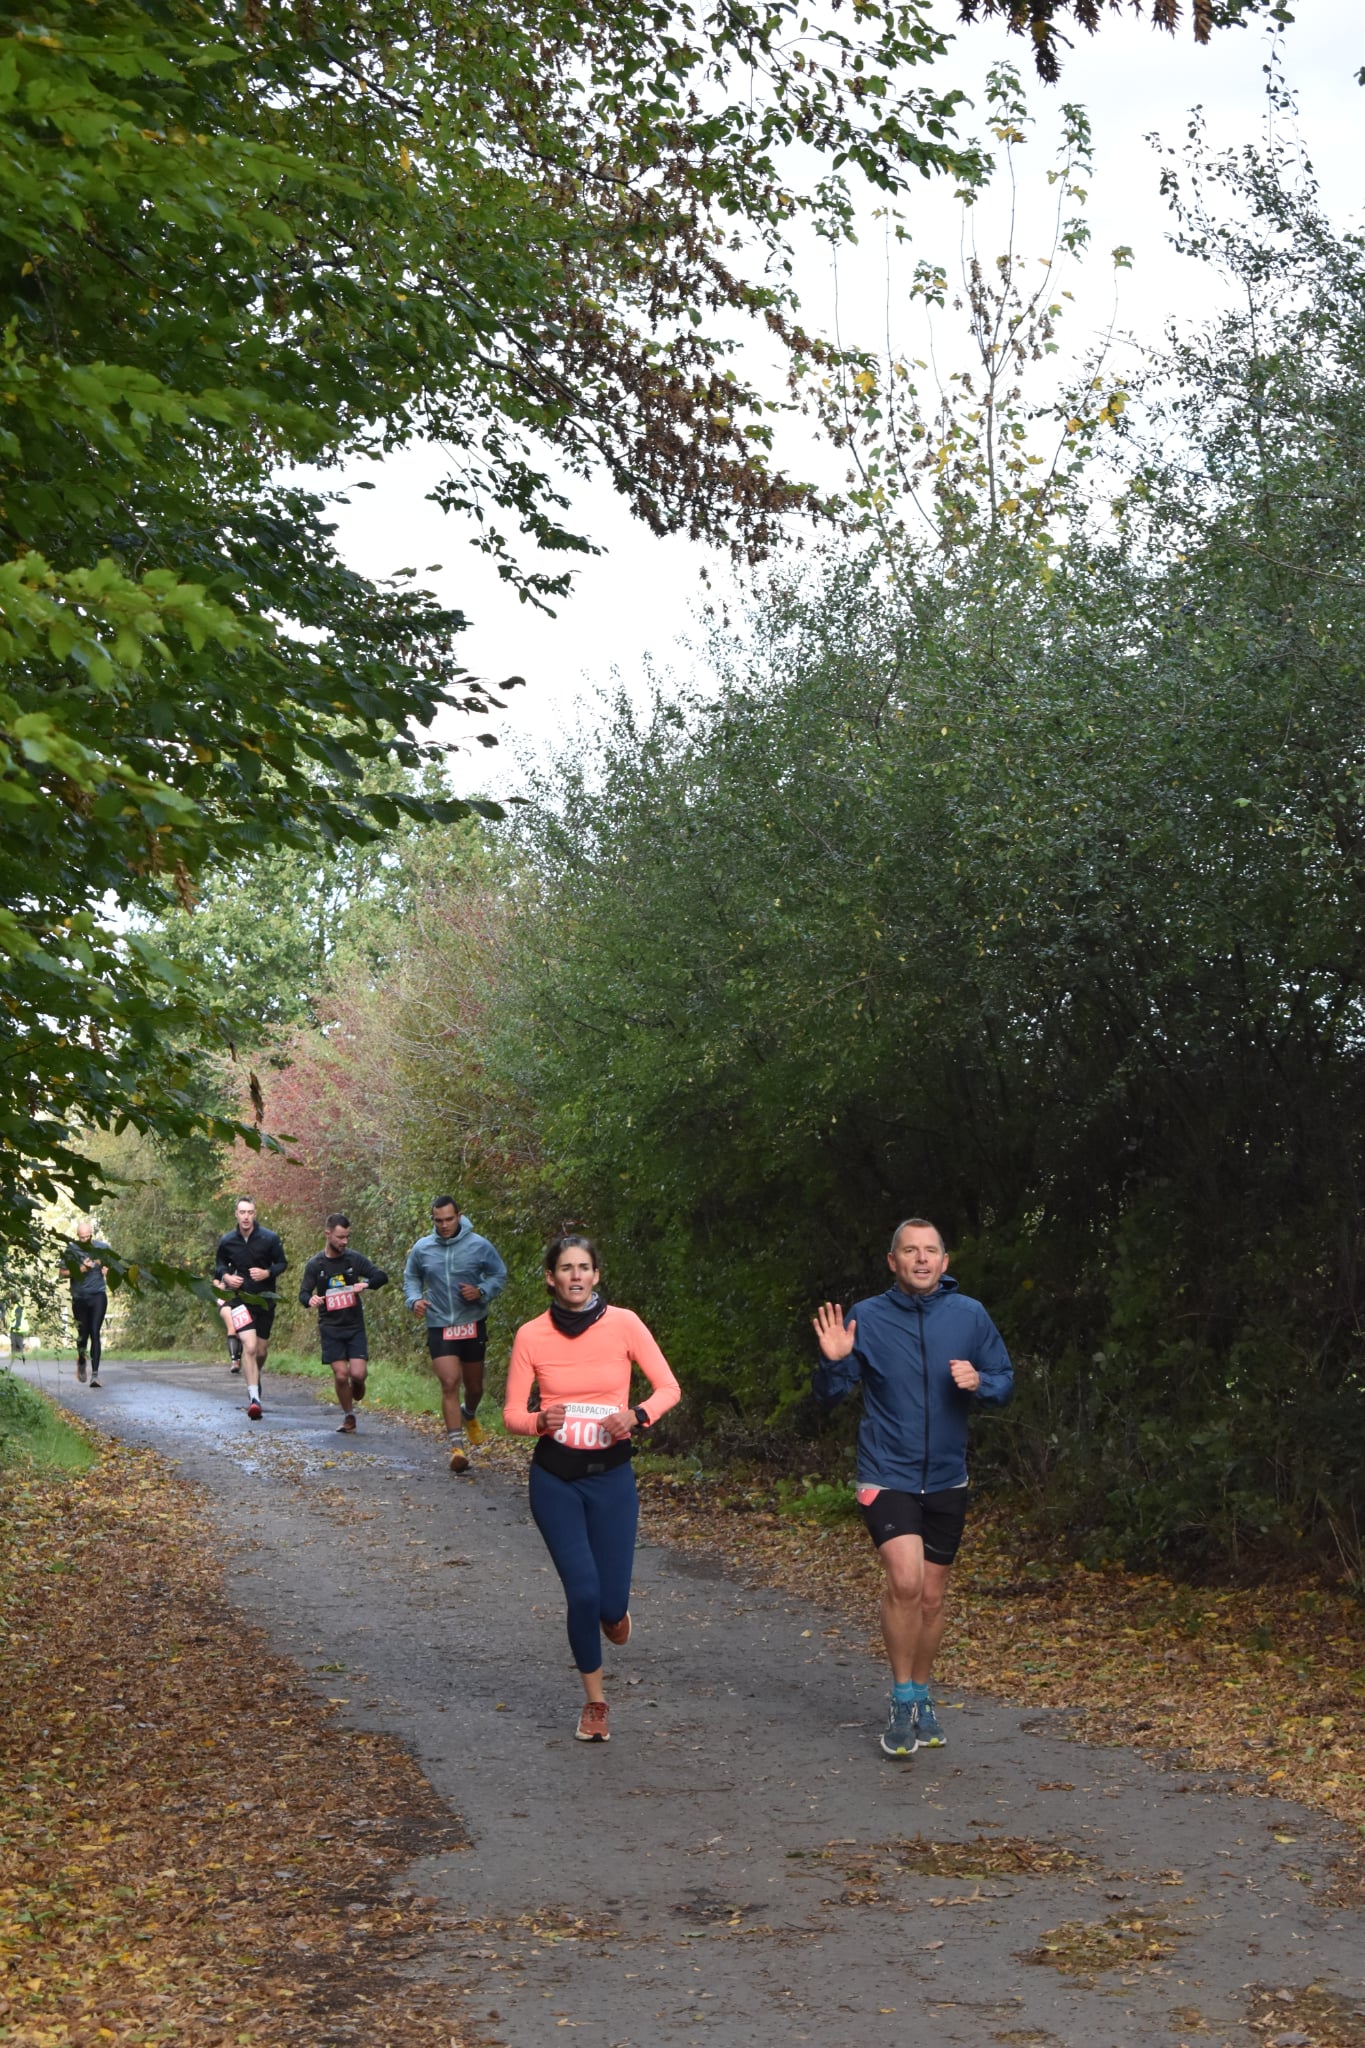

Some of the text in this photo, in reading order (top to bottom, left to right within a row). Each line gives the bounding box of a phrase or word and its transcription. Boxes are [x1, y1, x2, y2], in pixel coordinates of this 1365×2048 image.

[327, 1293, 354, 1308] 8111
[446, 1322, 474, 1336] 8058
[553, 1421, 612, 1448] 8106
